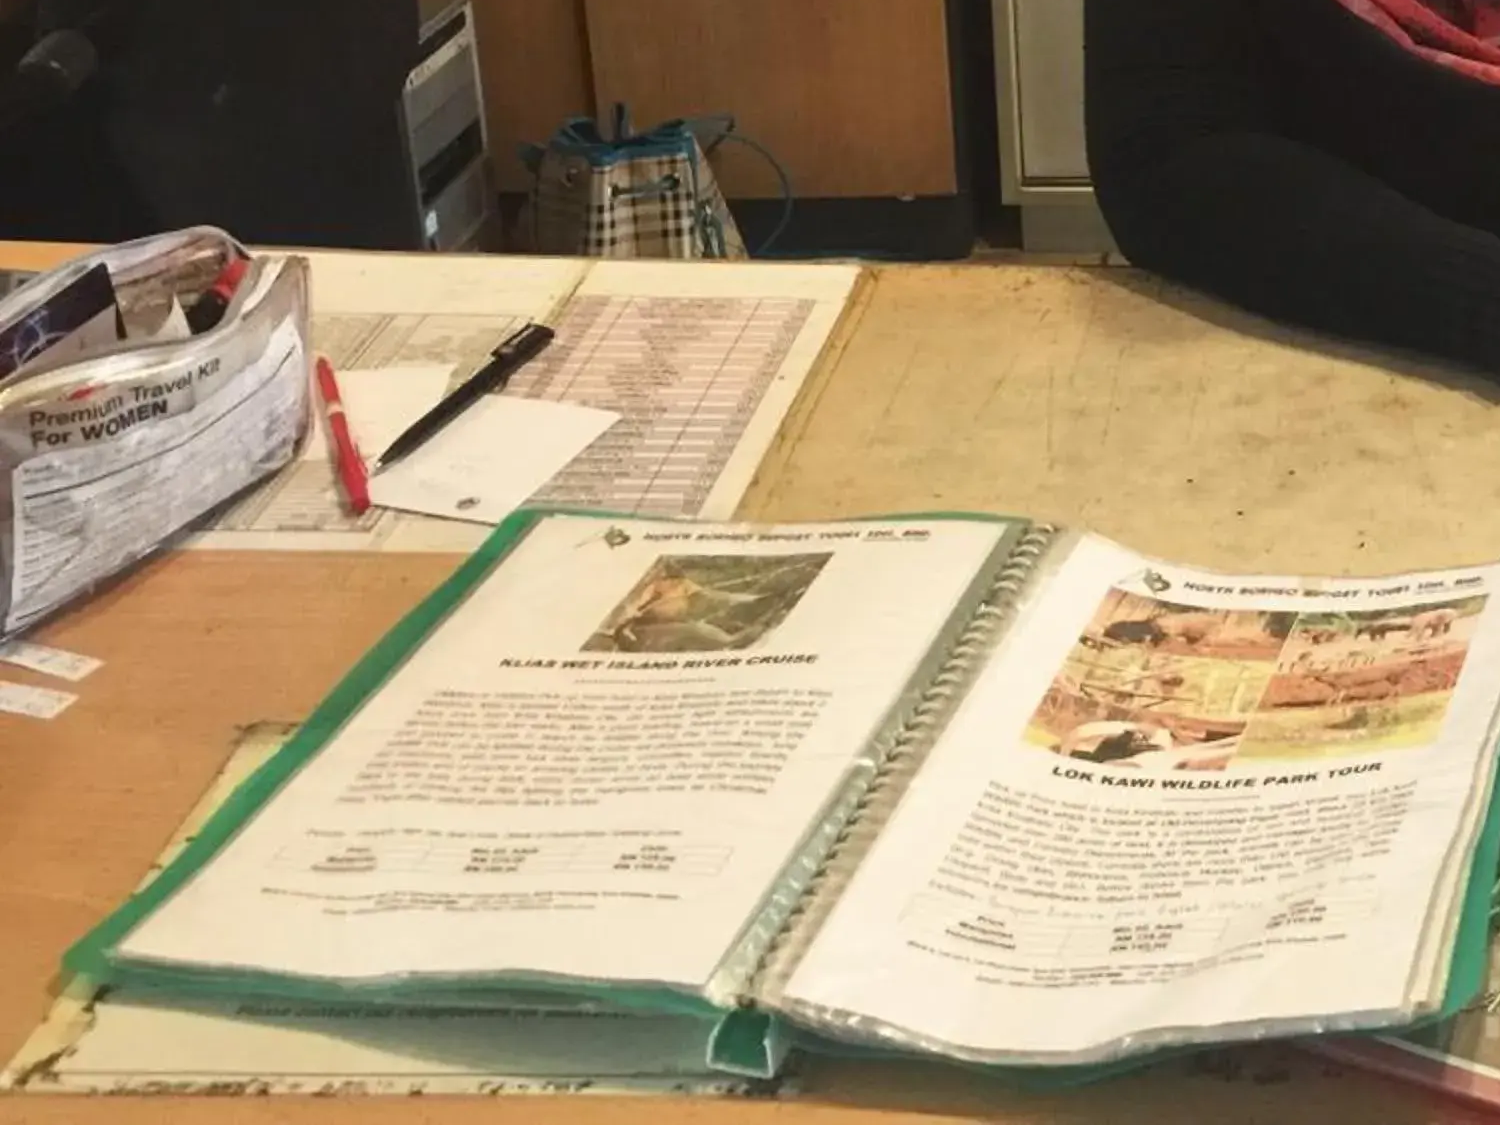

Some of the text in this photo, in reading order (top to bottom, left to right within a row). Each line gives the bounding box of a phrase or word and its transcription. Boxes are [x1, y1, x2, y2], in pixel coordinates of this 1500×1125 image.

[29, 357, 222, 427] Premium Travel Kit
[31, 399, 169, 448] For WOMEN
[562, 658, 605, 669] WET
[682, 658, 740, 669] RIVER
[746, 653, 818, 666] CRUISE
[1052, 761, 1384, 791] LOK KAWI WILDLIFE PARK TOUR
